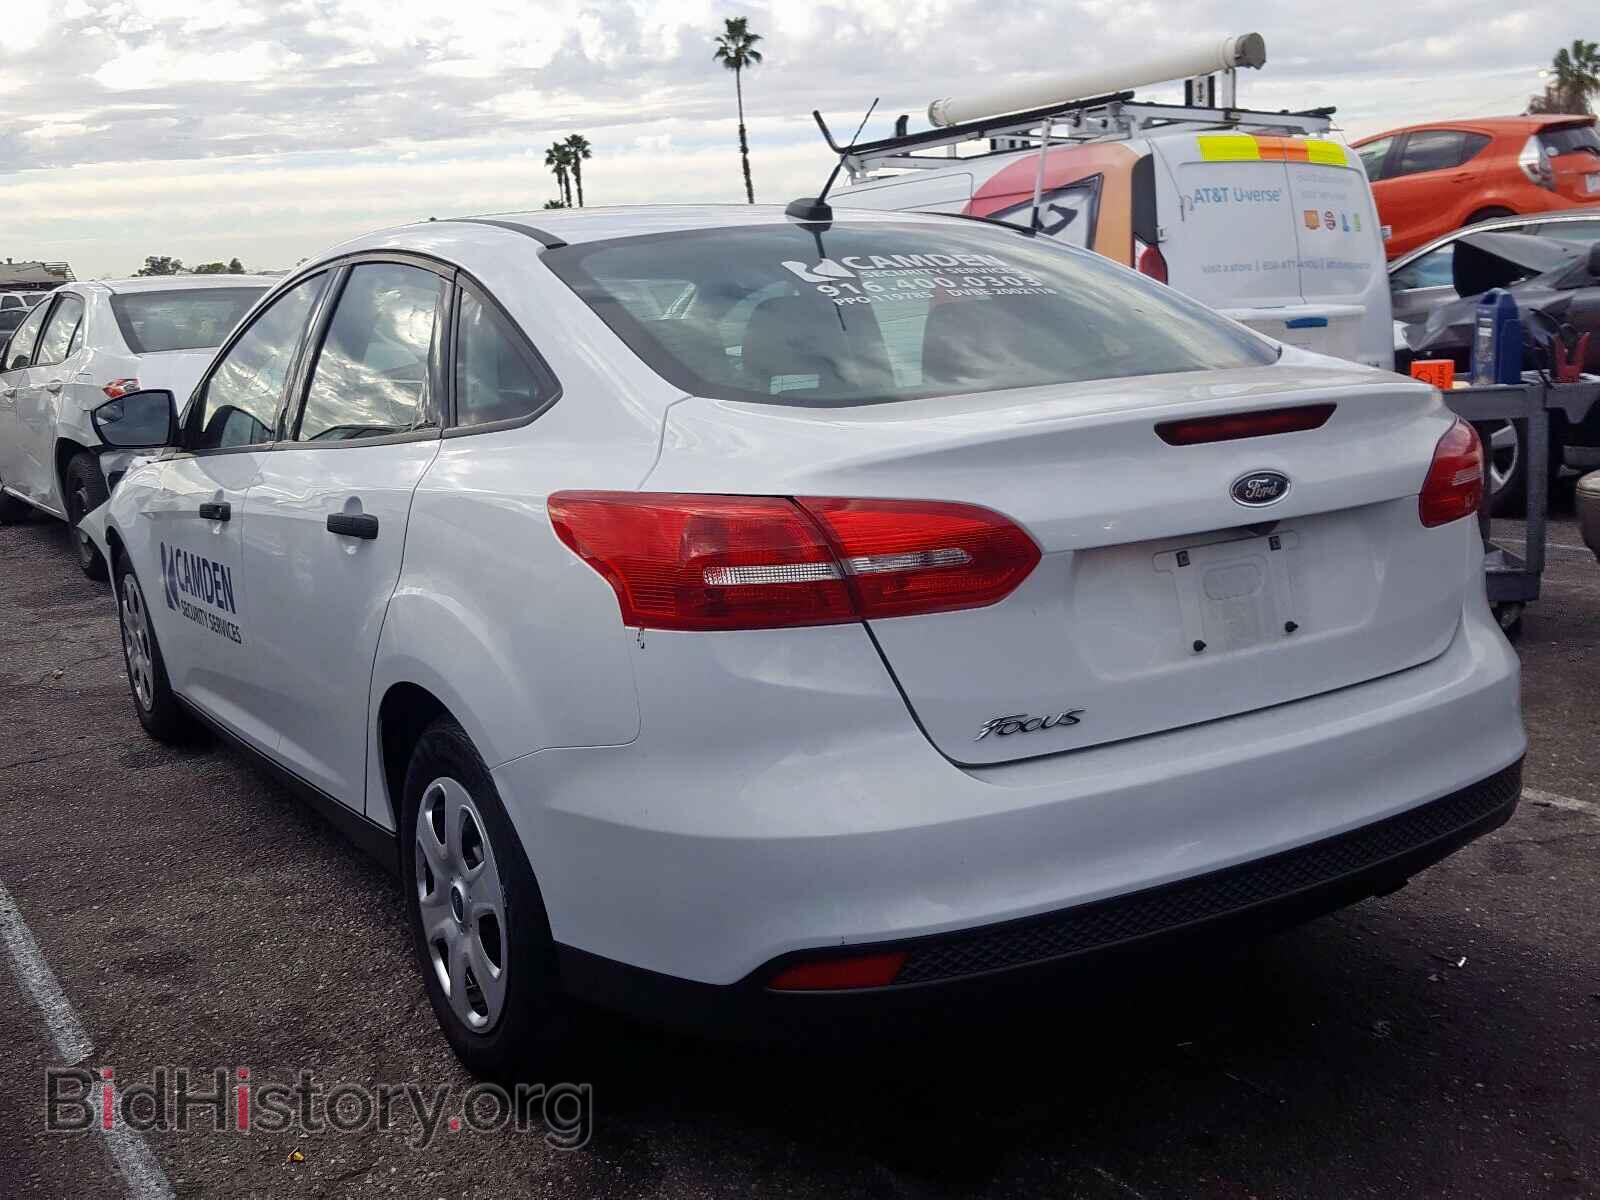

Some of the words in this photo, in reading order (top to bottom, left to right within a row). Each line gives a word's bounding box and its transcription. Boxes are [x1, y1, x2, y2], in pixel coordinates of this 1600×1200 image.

[1193, 187, 1229, 204] AT&T
[841, 254, 1009, 270] CAMDEN
[861, 267, 944, 278] SECURITY
[816, 276, 1043, 297] 916.400.0303
[832, 296, 871, 306] PPO
[1245, 478, 1279, 498] Ford
[176, 548, 237, 615] CAMDEN
[180, 599, 209, 629] SECURITY
[207, 612, 242, 645] SERVICES
